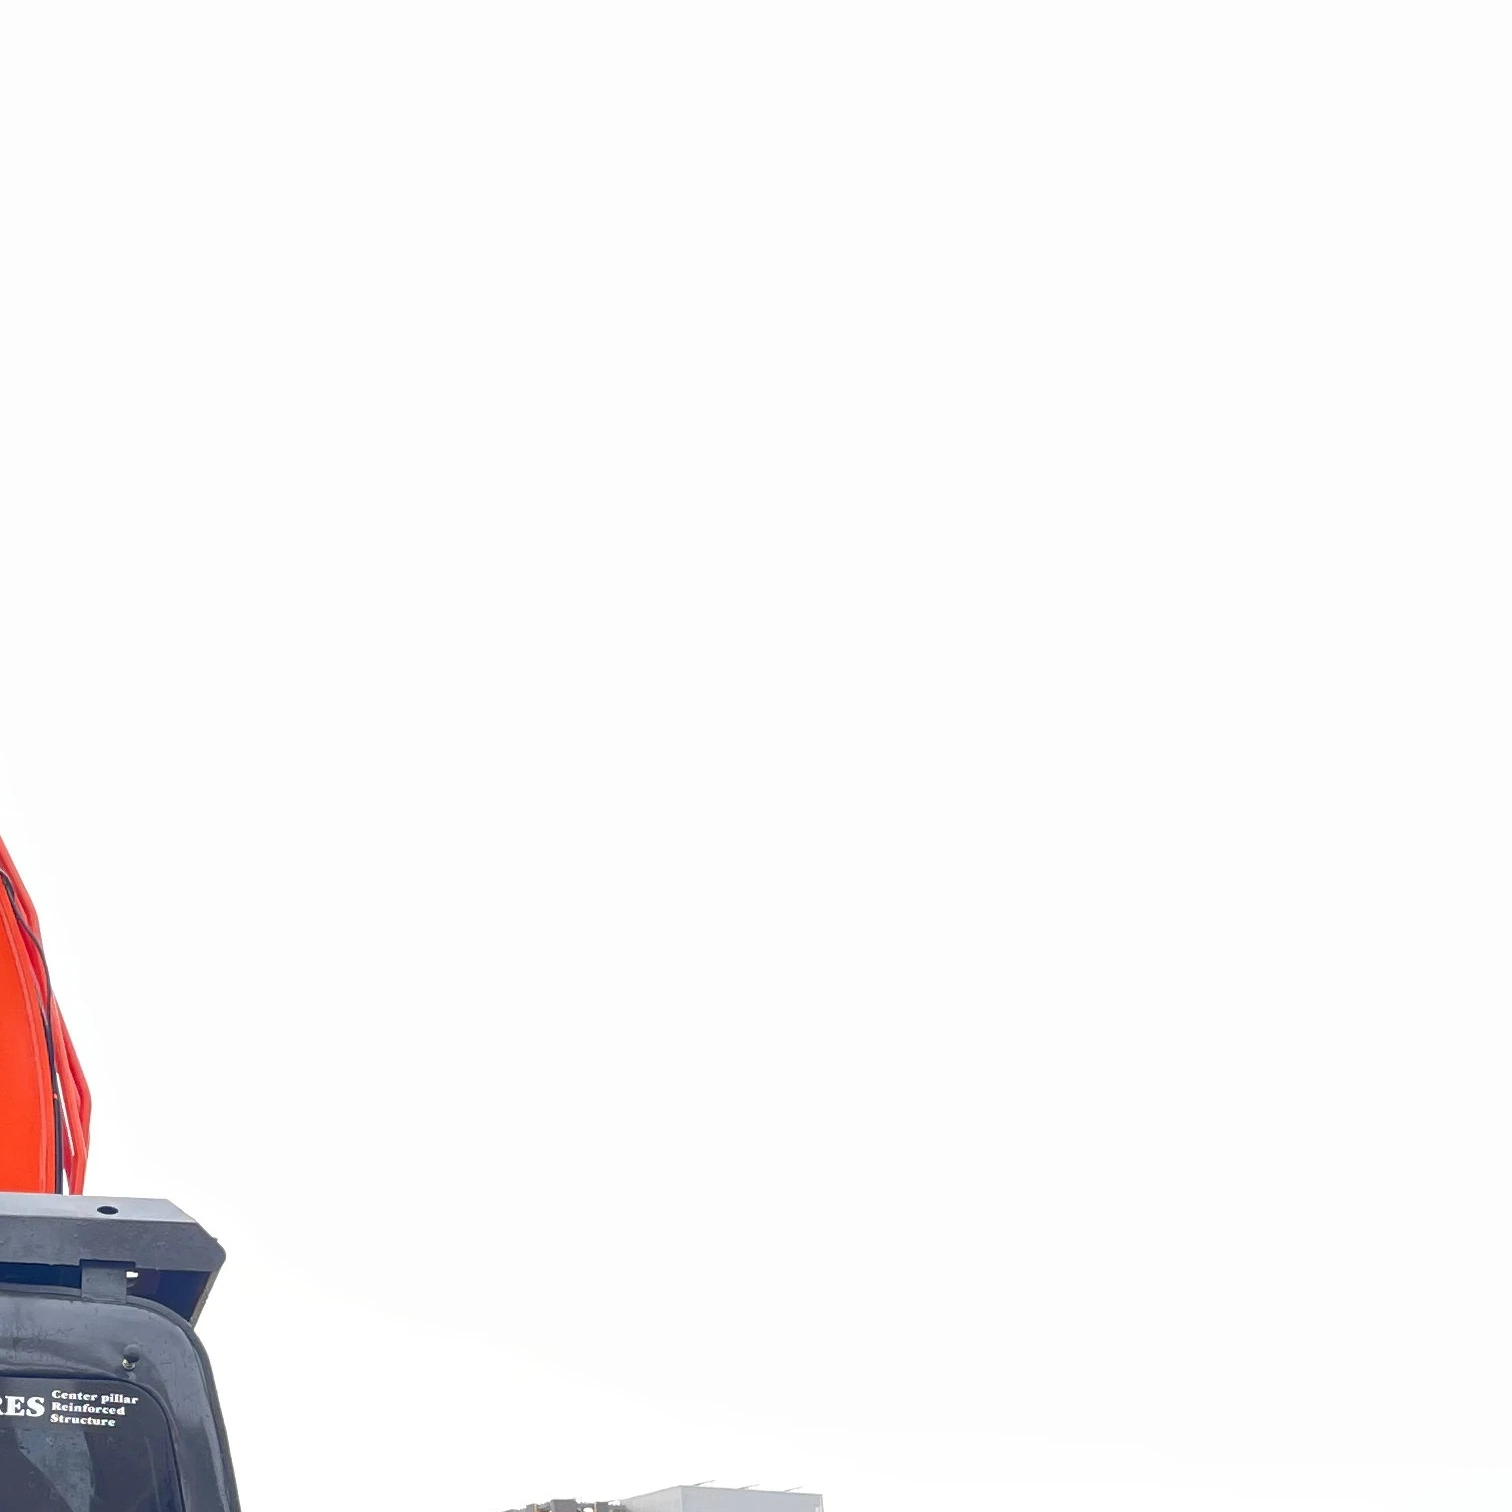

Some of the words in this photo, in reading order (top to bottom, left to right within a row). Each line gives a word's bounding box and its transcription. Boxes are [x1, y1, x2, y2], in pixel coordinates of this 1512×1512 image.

[51, 1389, 98, 1400] Center
[101, 1393, 138, 1405] pillar
[52, 1402, 126, 1416] Reinforced
[50, 1413, 116, 1427] Structure
